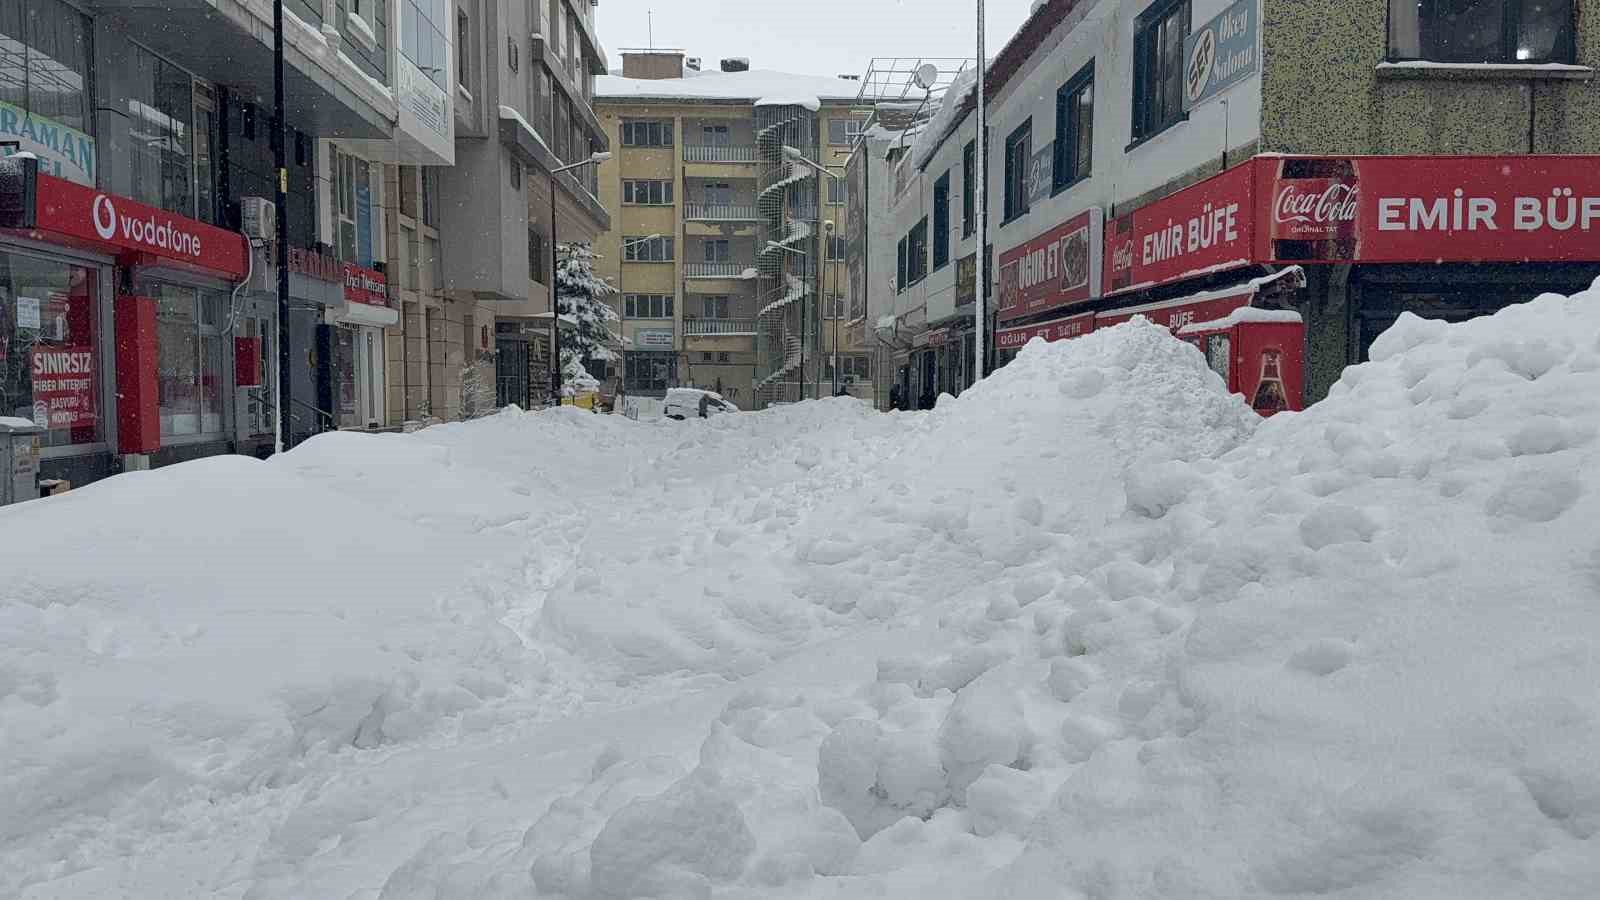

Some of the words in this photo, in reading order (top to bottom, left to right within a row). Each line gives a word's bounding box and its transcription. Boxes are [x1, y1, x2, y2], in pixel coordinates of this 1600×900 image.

[1274, 184, 1359, 223] Coca-Cola
[1378, 188, 1498, 231] EMİR
[120, 215, 201, 257] vodafone
[1143, 218, 1183, 266] EMİR
[1188, 202, 1238, 252] BÜFE
[1047, 241, 1060, 280] ET
[34, 352, 91, 374] SINIRSIZ
